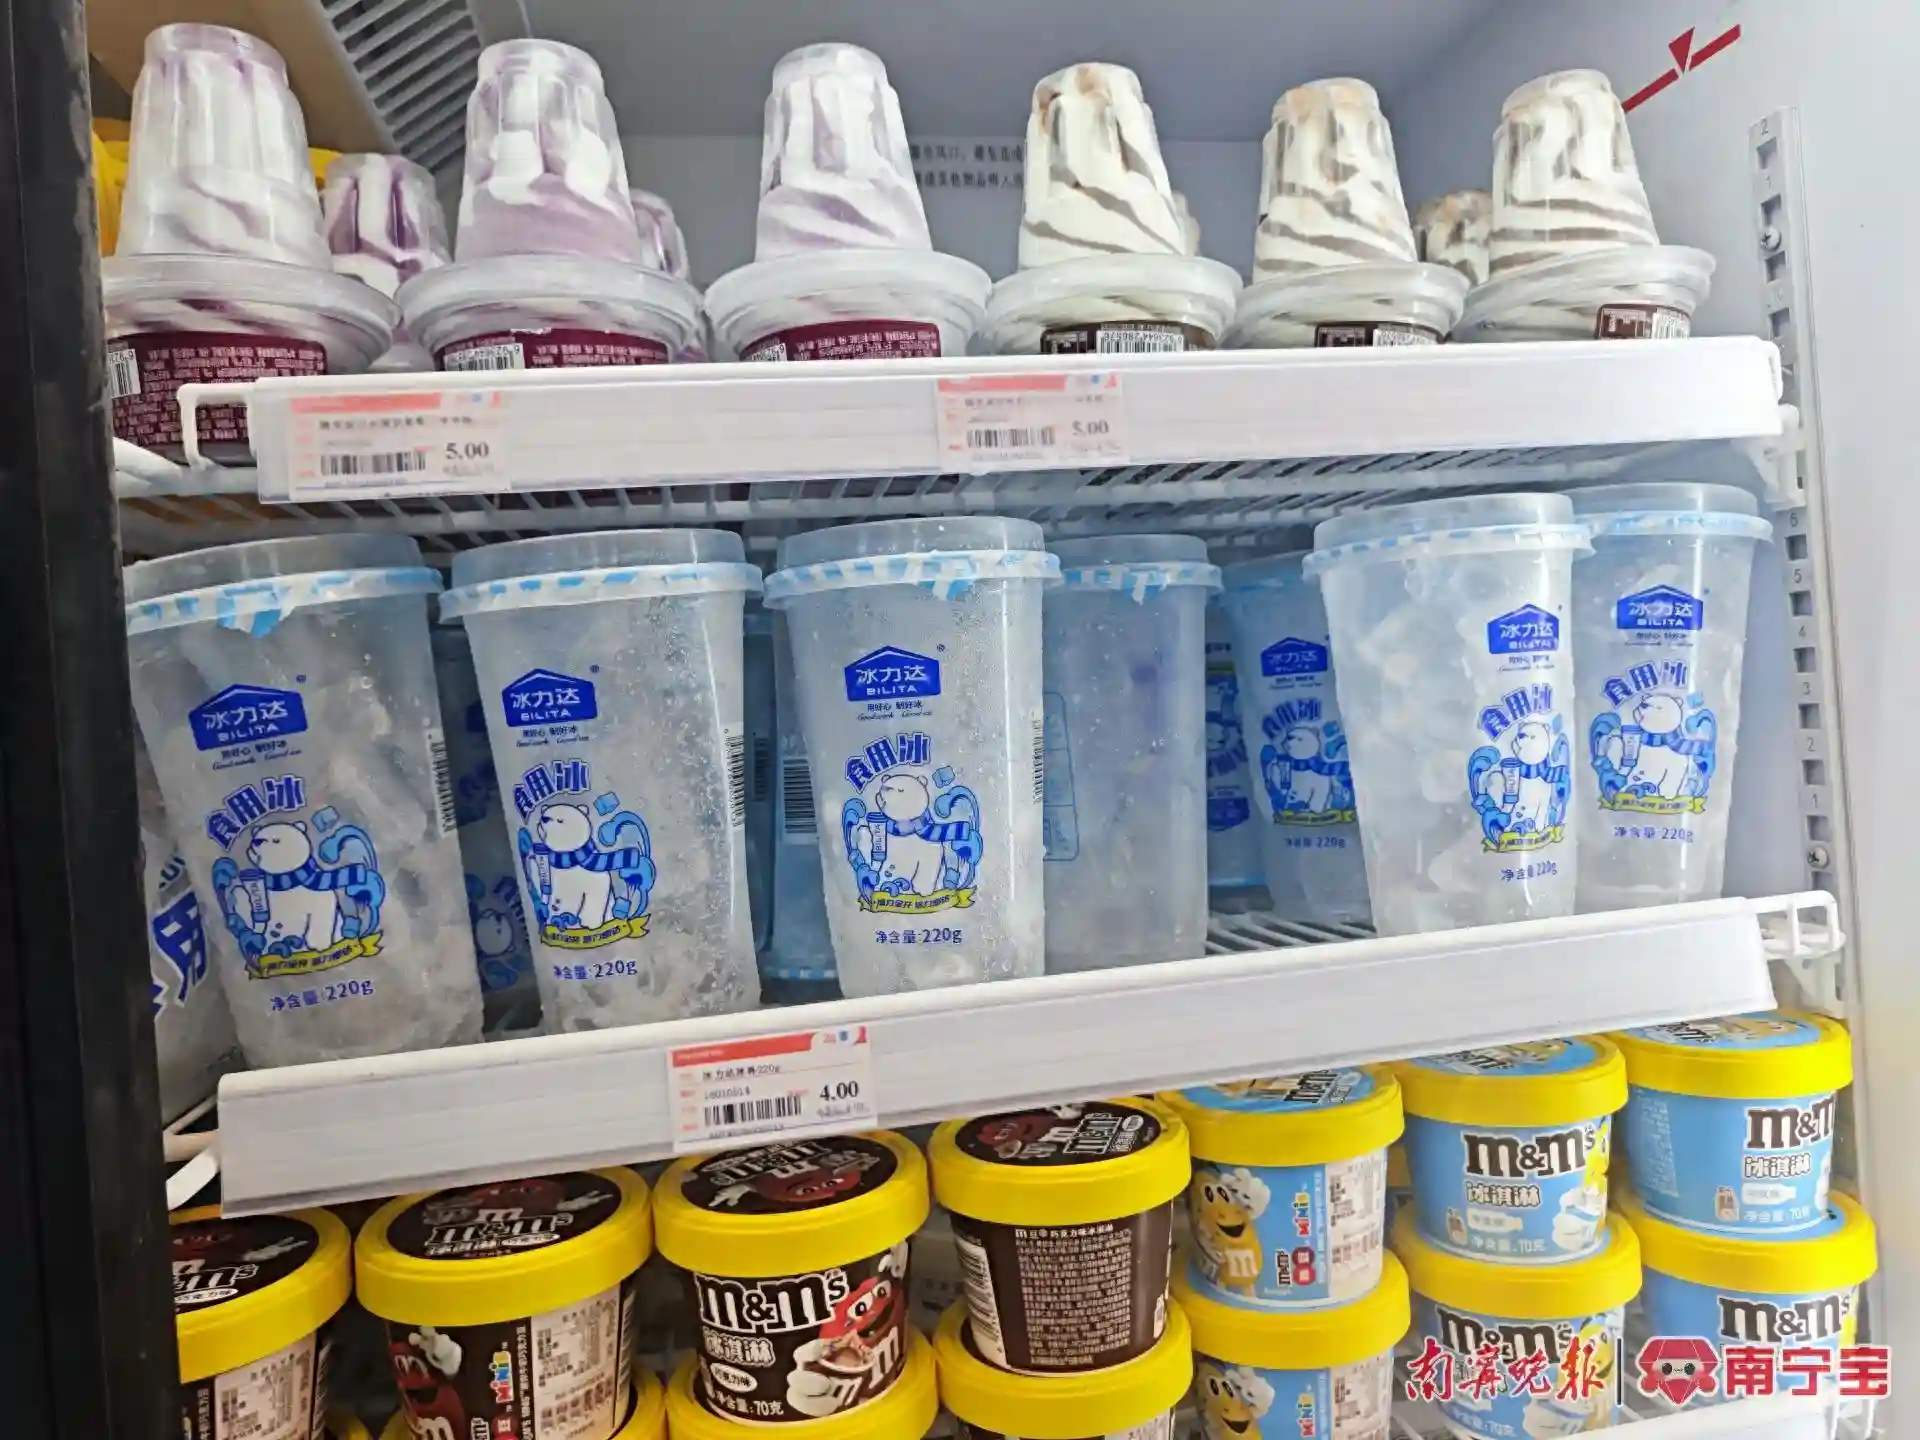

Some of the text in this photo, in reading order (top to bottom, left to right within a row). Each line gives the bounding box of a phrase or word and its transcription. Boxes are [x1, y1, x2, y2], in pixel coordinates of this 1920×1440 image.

[445, 441, 490, 460] 5.00
[1794, 568, 1802, 584] 5
[1627, 602, 1693, 618] 冰力达
[1499, 621, 1555, 639] 冰力达
[1636, 617, 1685, 627] BILITA
[856, 664, 927, 684] 冰力达
[1604, 660, 1688, 708] 食用冰
[510, 687, 581, 710] 冰力达
[866, 686, 918, 696] BILITA
[1802, 681, 1811, 696] 3
[202, 700, 289, 731] 冰力达
[520, 709, 572, 722] BILITA
[867, 702, 892, 712] 用好心
[1479, 684, 1553, 740] 食用冰
[217, 723, 281, 743] BILITA
[1807, 737, 1815, 752] 2
[845, 732, 931, 794] 食用冰
[513, 759, 590, 825] 食用冰
[206, 774, 305, 851] 食用冰
[875, 927, 963, 945] 净含量:220g
[819, 1080, 859, 1102] 4.00
[1461, 1124, 1596, 1178] m&m's
[1744, 1153, 1811, 1178] 冰淇淋
[1466, 1182, 1541, 1208] 冰淇淋
[695, 1269, 850, 1332] m&m's
[1718, 1293, 1851, 1343] m&m's
[703, 1327, 775, 1367] 冰淇淋
